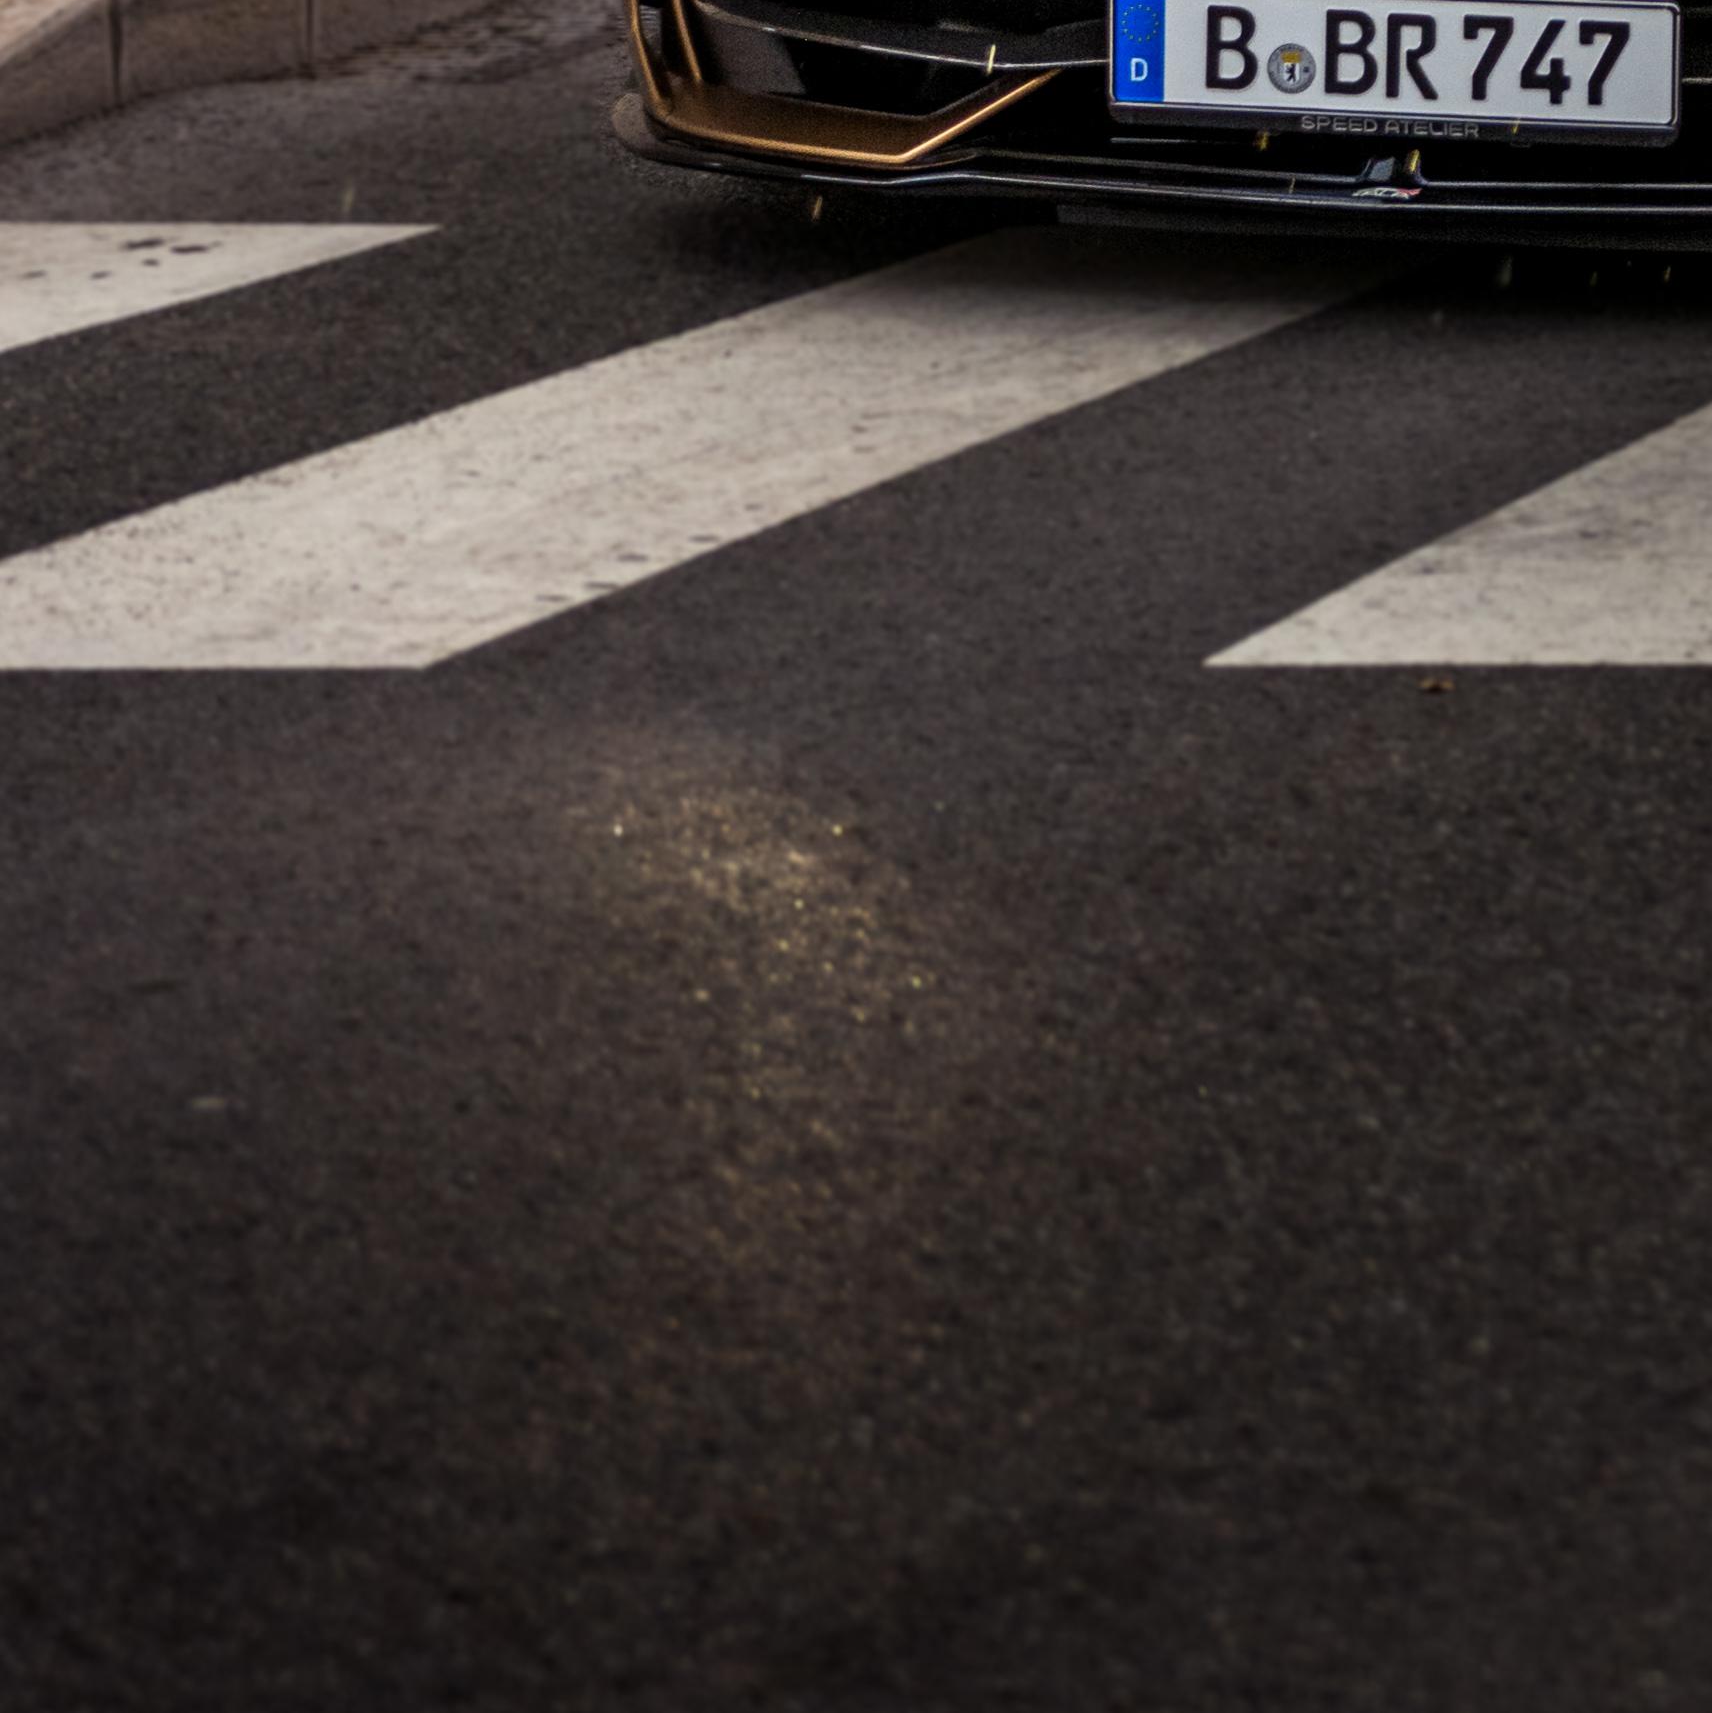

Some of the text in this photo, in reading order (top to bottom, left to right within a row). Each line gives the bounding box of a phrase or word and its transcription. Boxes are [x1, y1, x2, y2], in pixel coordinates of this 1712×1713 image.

[1205, 4, 1632, 106] B BR 747
[1129, 58, 1149, 82] D
[1301, 115, 1480, 139] SPEED ATELIER
